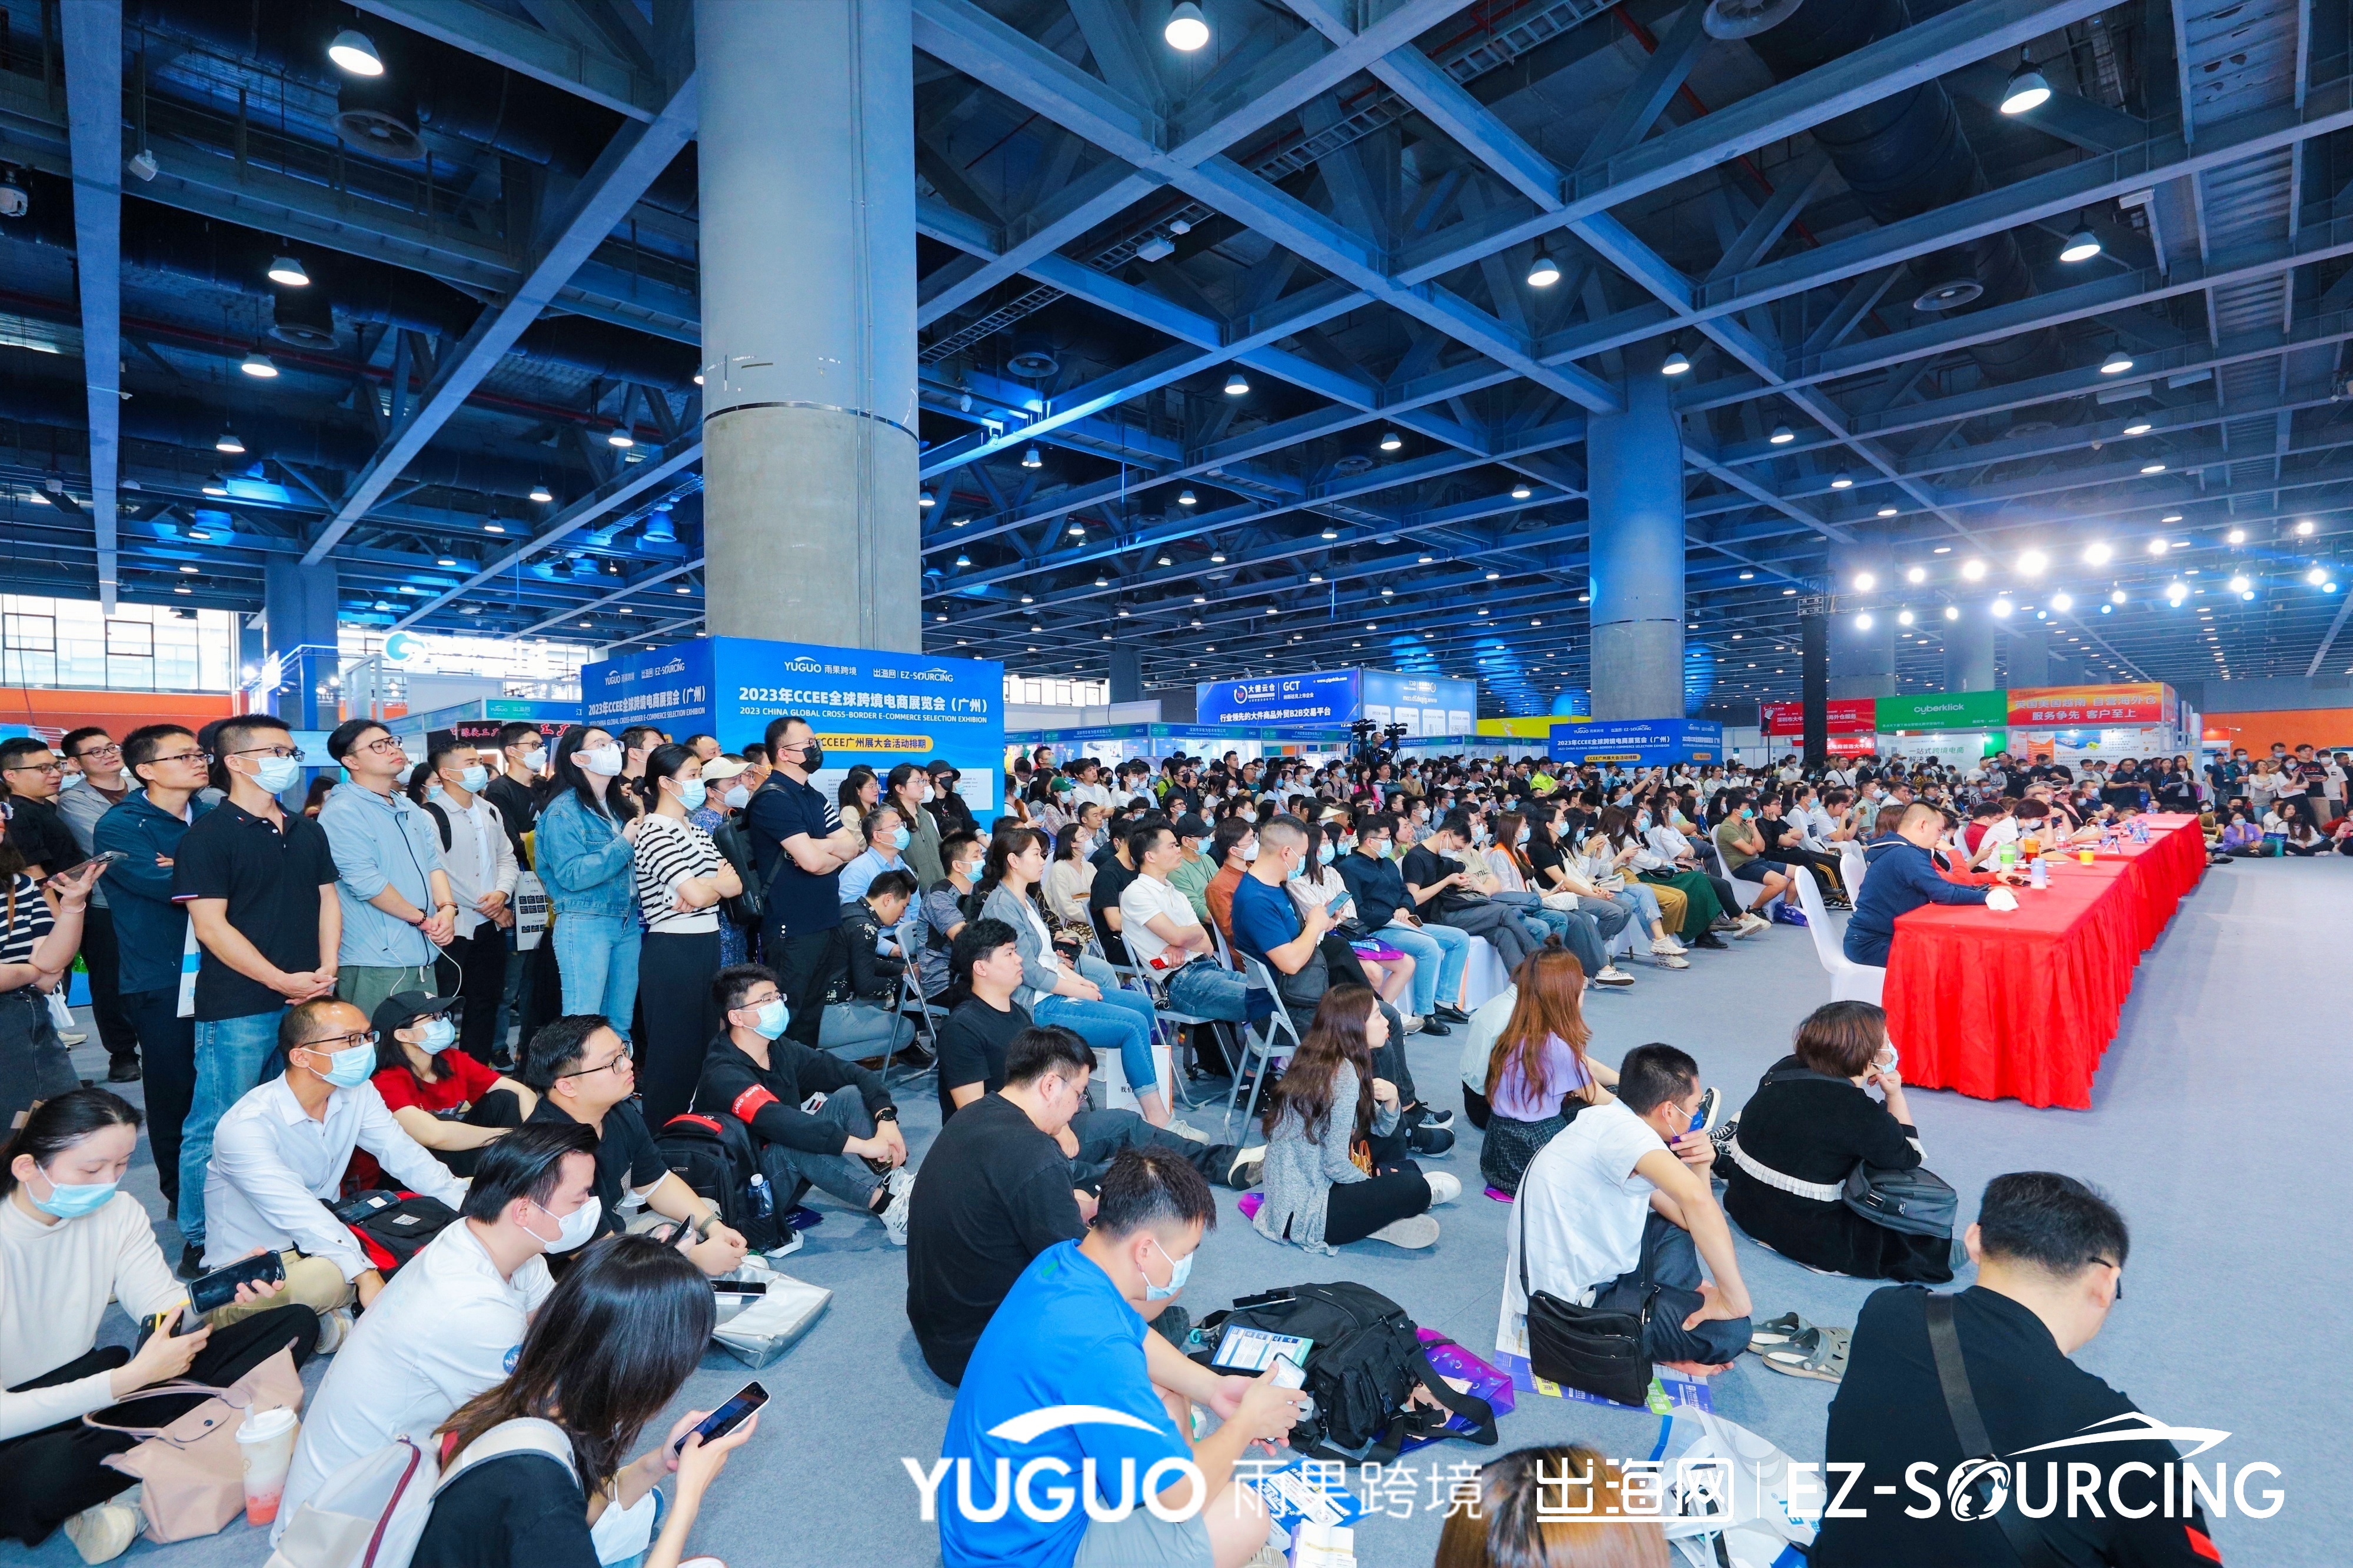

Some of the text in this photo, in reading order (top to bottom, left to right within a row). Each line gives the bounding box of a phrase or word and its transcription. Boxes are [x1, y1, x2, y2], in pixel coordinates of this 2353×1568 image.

[655, 663, 685, 676] EZ-SOURCING
[784, 661, 822, 673] YUGUO
[824, 664, 857, 676] 雨果跨境
[873, 668, 896, 678] 出海网
[605, 675, 621, 686] YUGUO
[900, 671, 954, 682] EZ-SOURCING
[1248, 683, 1276, 694] 大健云仓
[1283, 681, 1300, 691] GCT
[2015, 695, 2156, 709] 英国美国越南 自营海外仓
[620, 715, 643, 724] CROSS-BORDER
[643, 711, 667, 721] E-COMMERCE
[667, 709, 686, 718] SELECTION
[686, 707, 705, 716] EXHIBION
[740, 707, 760, 715] 2023
[763, 708, 788, 716] CHINA
[790, 709, 820, 717] GLOBAL
[822, 710, 877, 719] CROSS-BORDER
[878, 713, 921, 721] E-COMMERCE
[1220, 707, 1332, 723] 行业领先的大件商品外贸B2B交易平台
[1914, 704, 1965, 715] cyberklick
[2032, 709, 2136, 721] 服务争先 客户至上
[821, 737, 926, 749] CCEE广州展大会活动排期
[1909, 747, 1965, 755] 一站式跨境电商
